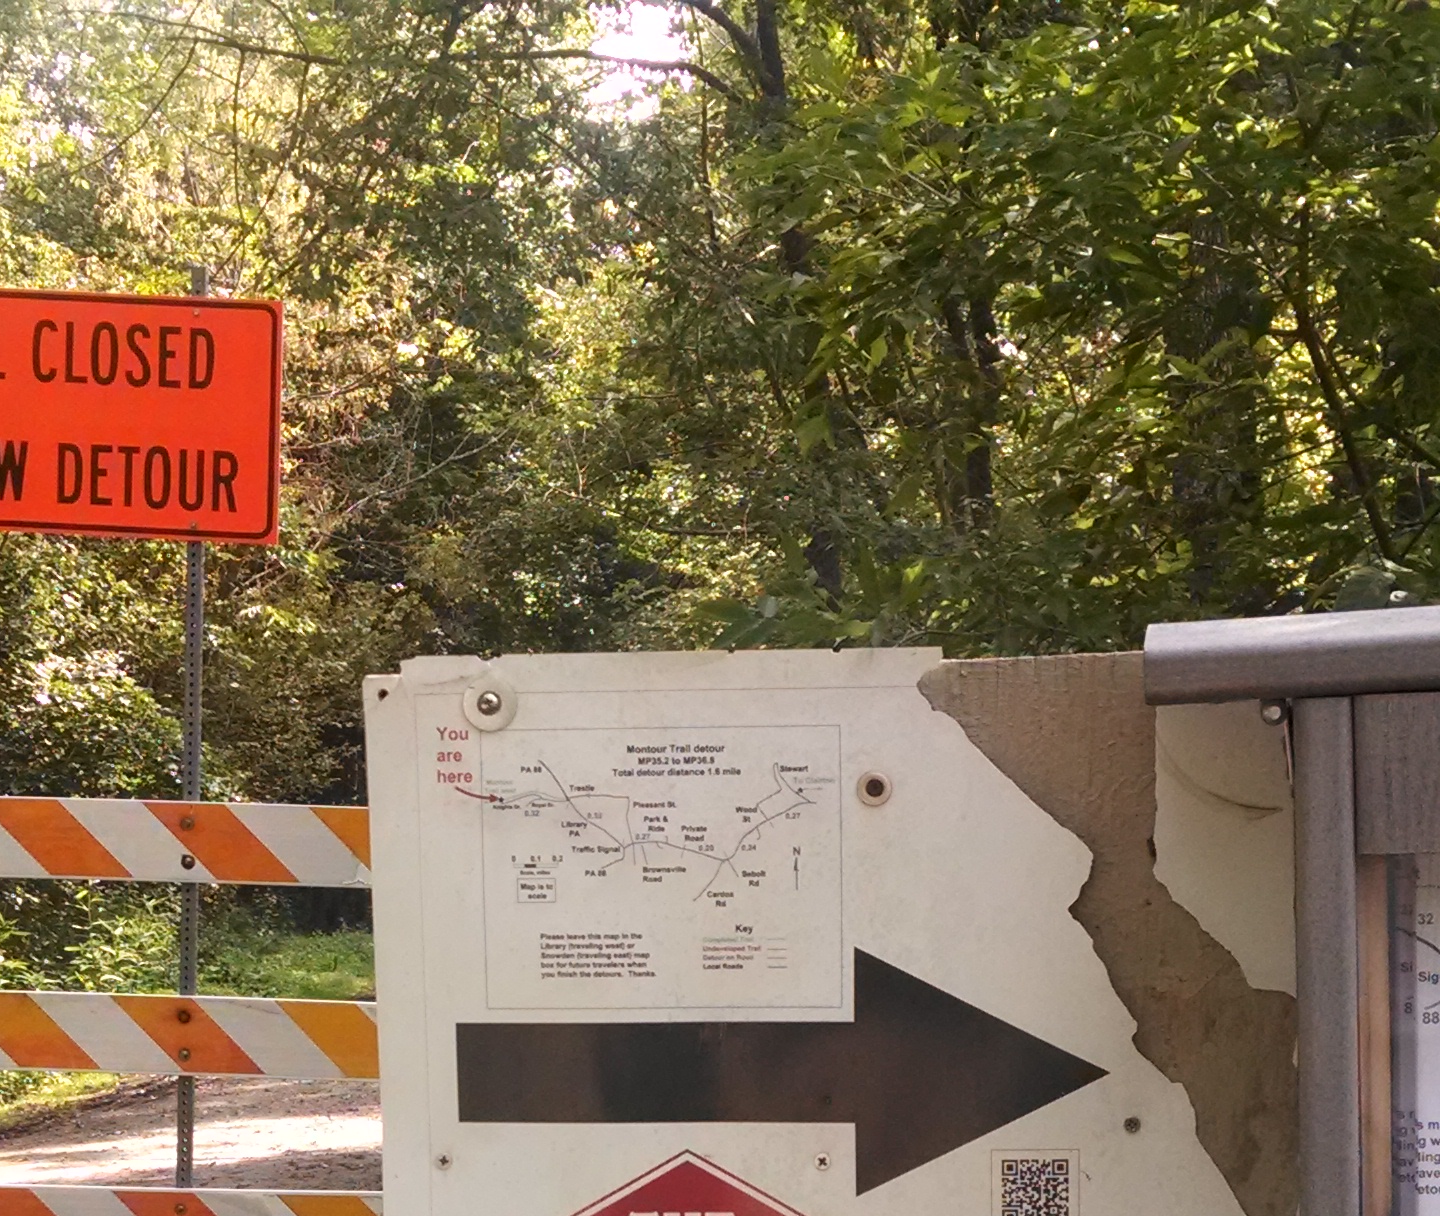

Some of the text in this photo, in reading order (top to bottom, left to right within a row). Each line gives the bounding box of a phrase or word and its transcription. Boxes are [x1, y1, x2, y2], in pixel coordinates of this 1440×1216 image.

[31, 319, 216, 390] CLOSED
[56, 442, 240, 513] DETOUR
[436, 727, 469, 741] You
[626, 744, 725, 754] Montour Trail detour
[437, 751, 462, 762] are
[672, 757, 681, 765] to
[520, 766, 532, 774] PA
[612, 769, 634, 777] Total
[636, 768, 665, 776] detour
[667, 768, 705, 776] distance
[722, 767, 741, 775] mile
[437, 770, 473, 783] here
[684, 834, 704, 842] Road
[735, 924, 753, 934] Key
[1422, 1012, 1440, 1024] 88
